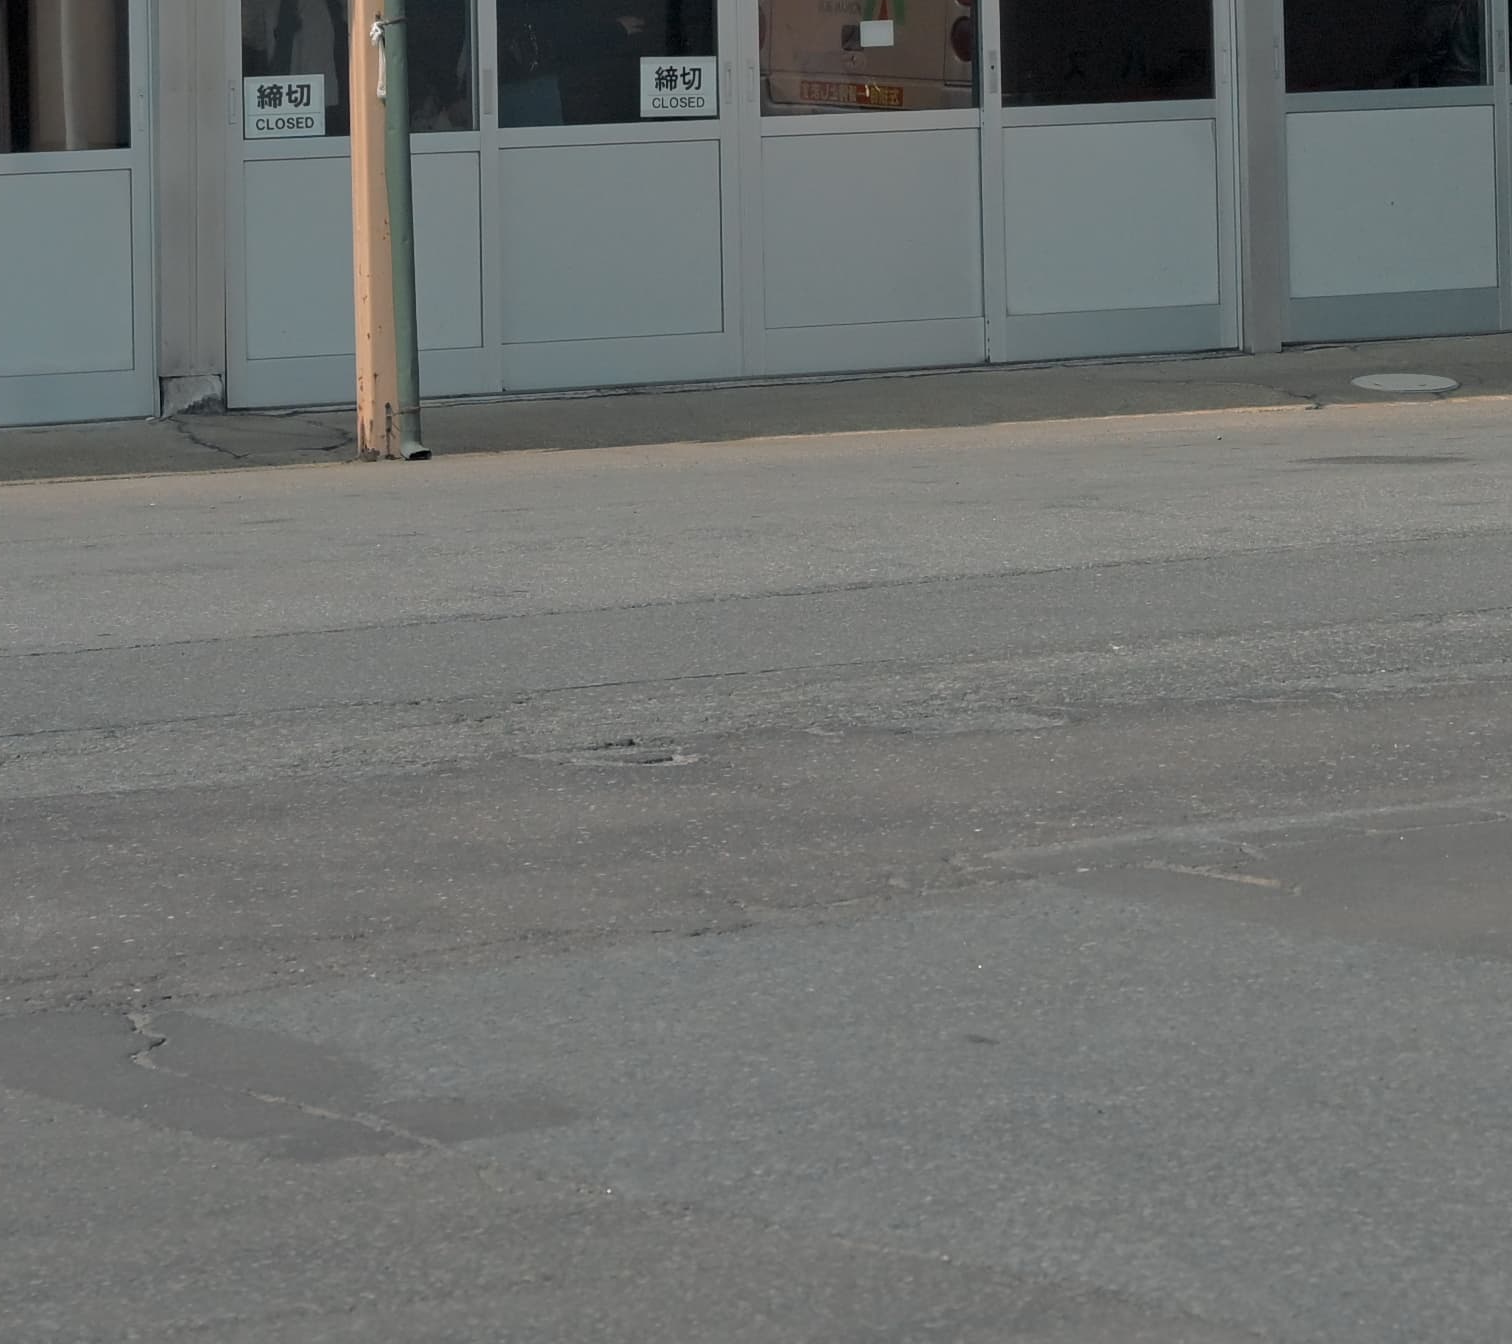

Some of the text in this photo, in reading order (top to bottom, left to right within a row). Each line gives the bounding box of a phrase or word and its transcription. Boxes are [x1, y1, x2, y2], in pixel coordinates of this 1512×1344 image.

[653, 65, 703, 92] 締切
[256, 83, 312, 109] 締切
[651, 95, 706, 109] CLOSED
[255, 115, 315, 131] CLOSED
